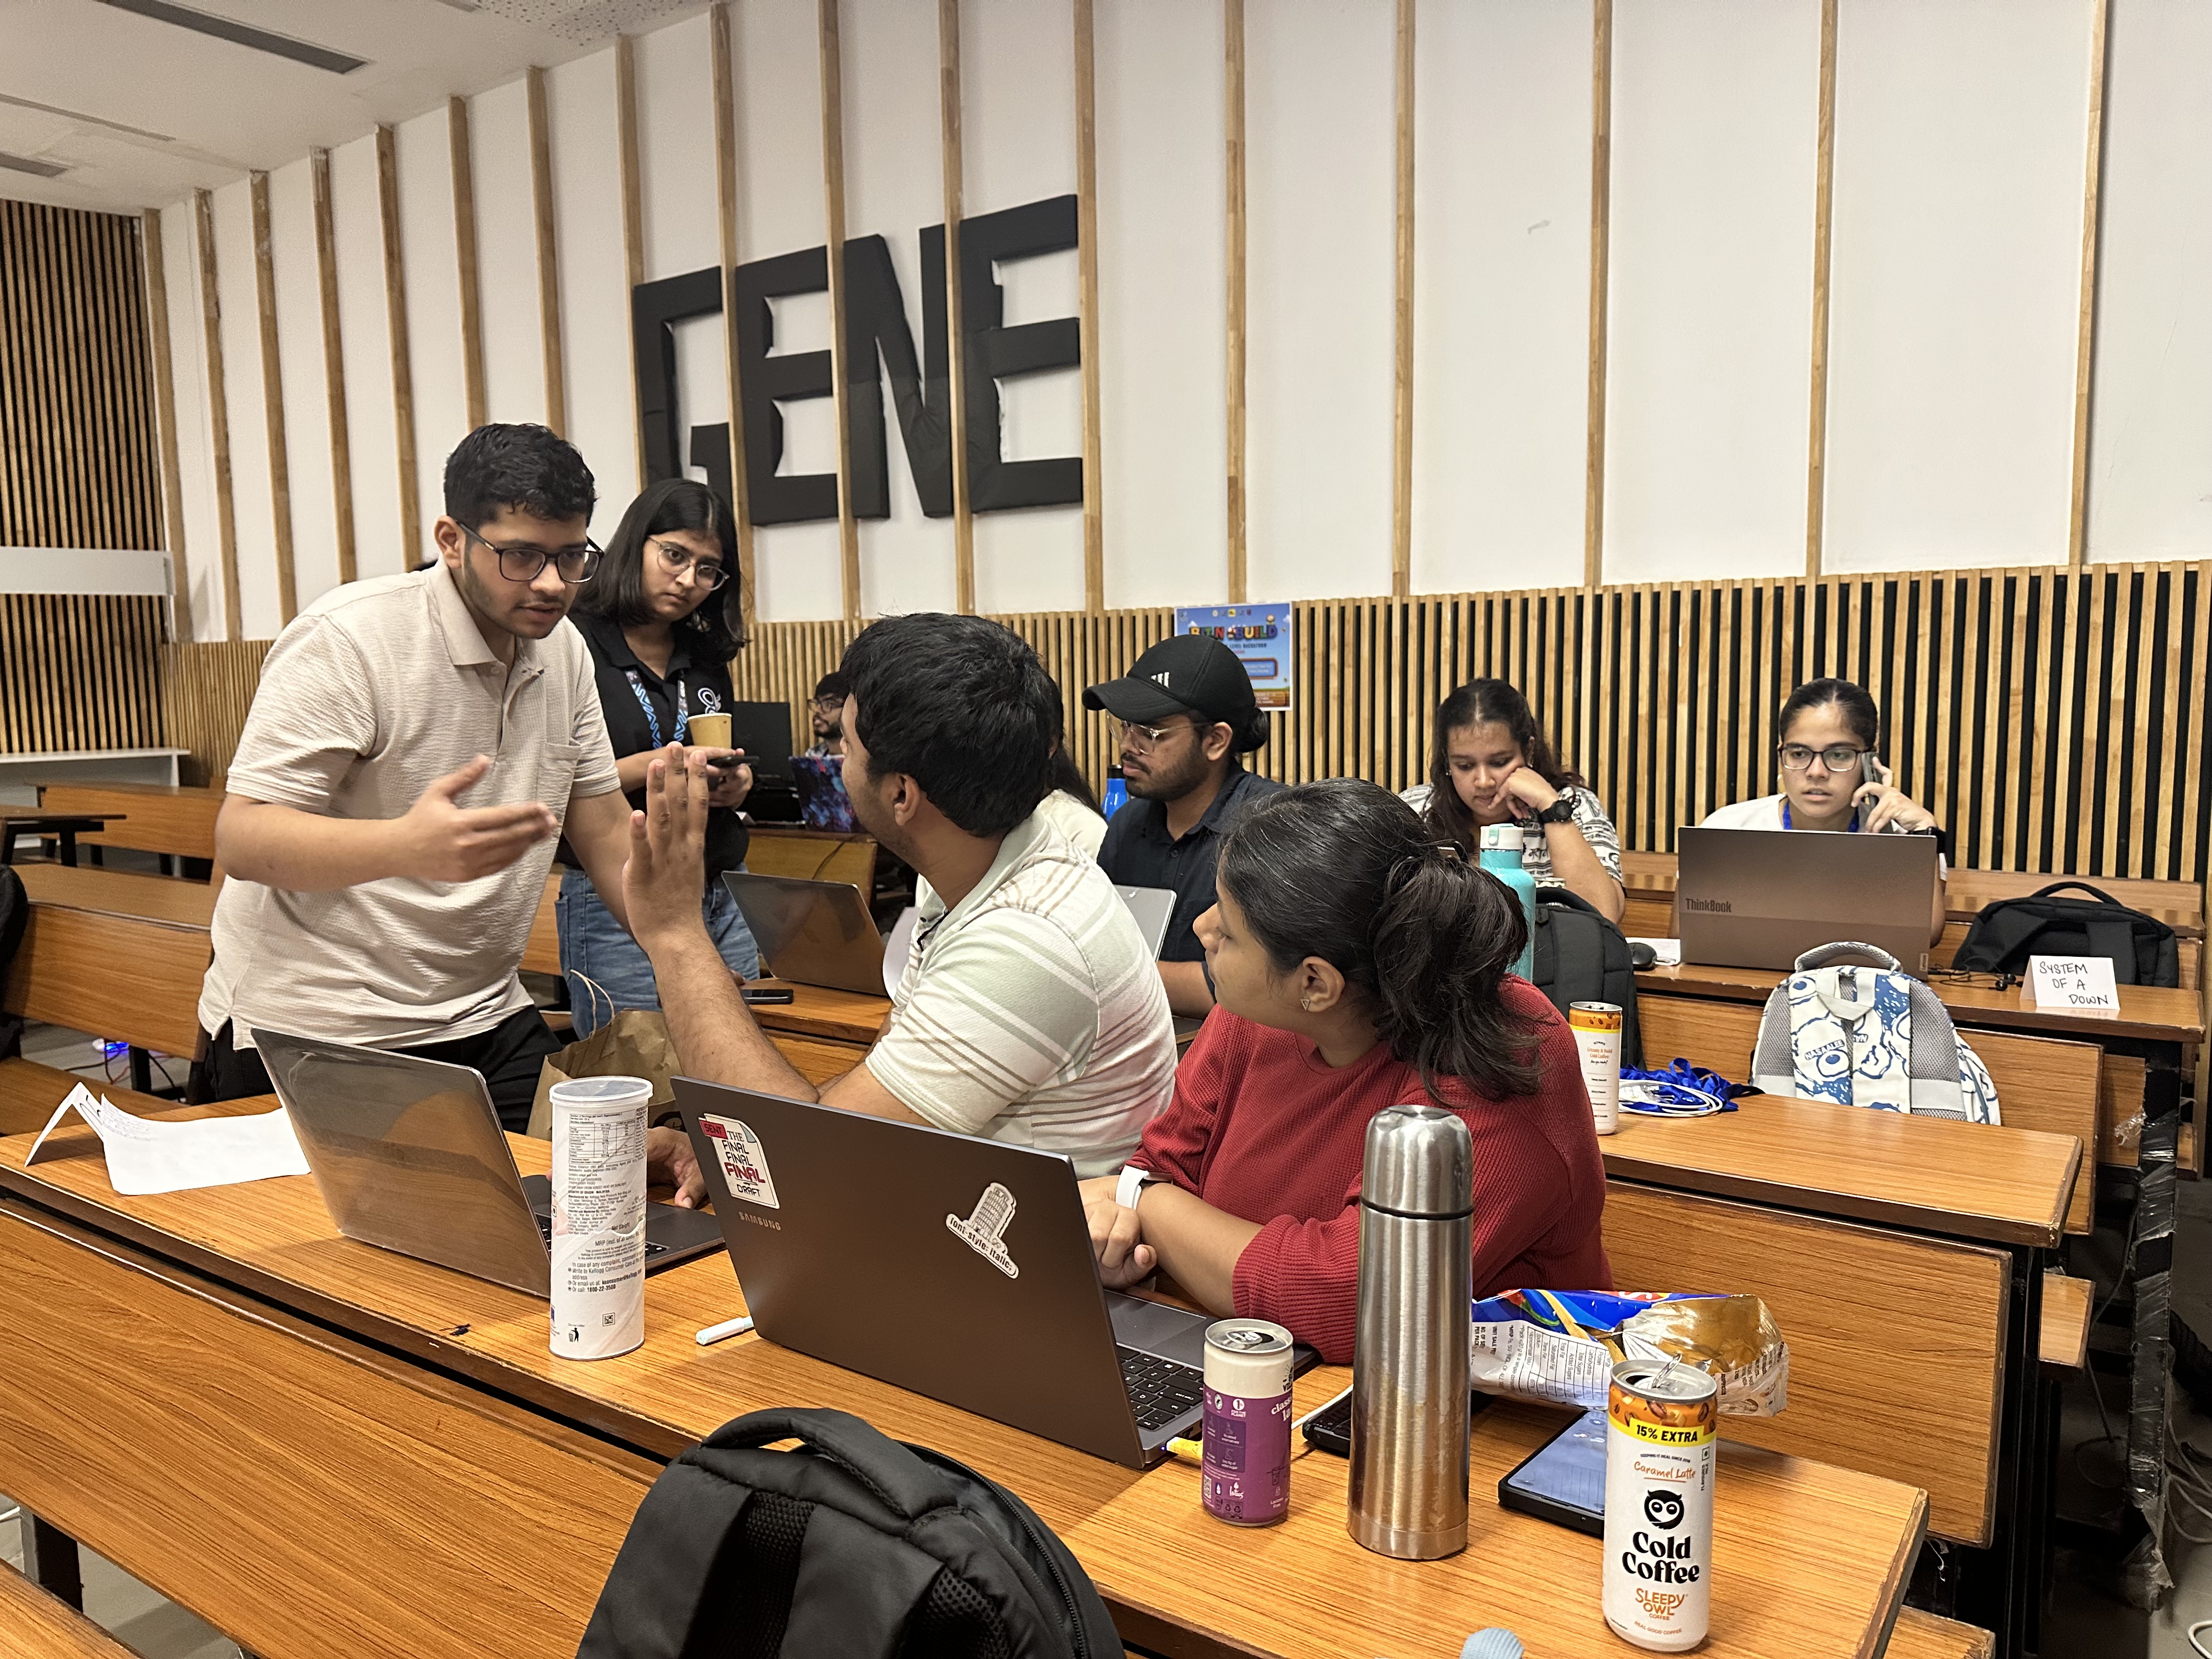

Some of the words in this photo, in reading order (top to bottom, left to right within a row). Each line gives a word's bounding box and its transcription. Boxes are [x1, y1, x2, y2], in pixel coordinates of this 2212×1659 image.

[634, 194, 1084, 526] GENE
[1214, 626, 1224, 640] N
[1234, 624, 1278, 640] BUILD
[1685, 898, 1732, 913] ThinkBook
[2039, 961, 2088, 974] SYSTEM
[2052, 978, 2067, 989] OF
[2076, 979, 2085, 990] A
[2068, 994, 2109, 1005] DOWN
[704, 1124, 723, 1136] SENT
[727, 1131, 744, 1142] THE
[721, 1140, 749, 1154] FINAL
[726, 1152, 753, 1166] FINAL
[724, 1163, 766, 1183] FINAL
[736, 1184, 760, 1197] DRAFT
[738, 1211, 781, 1231] SAMSUNG
[605, 1263, 624, 1272] Consumer
[1271, 1396, 1292, 1415] class
[1637, 1424, 1658, 1440] 15%
[1661, 1430, 1697, 1442] EXTRA
[1634, 1461, 1673, 1479] Caramel
[1675, 1467, 1696, 1480] Latte
[1633, 1531, 1691, 1559] Cold
[1622, 1551, 1700, 1584] Coffee
[1635, 1588, 1685, 1609] SLEEPY
[1643, 1602, 1675, 1616] OWL
